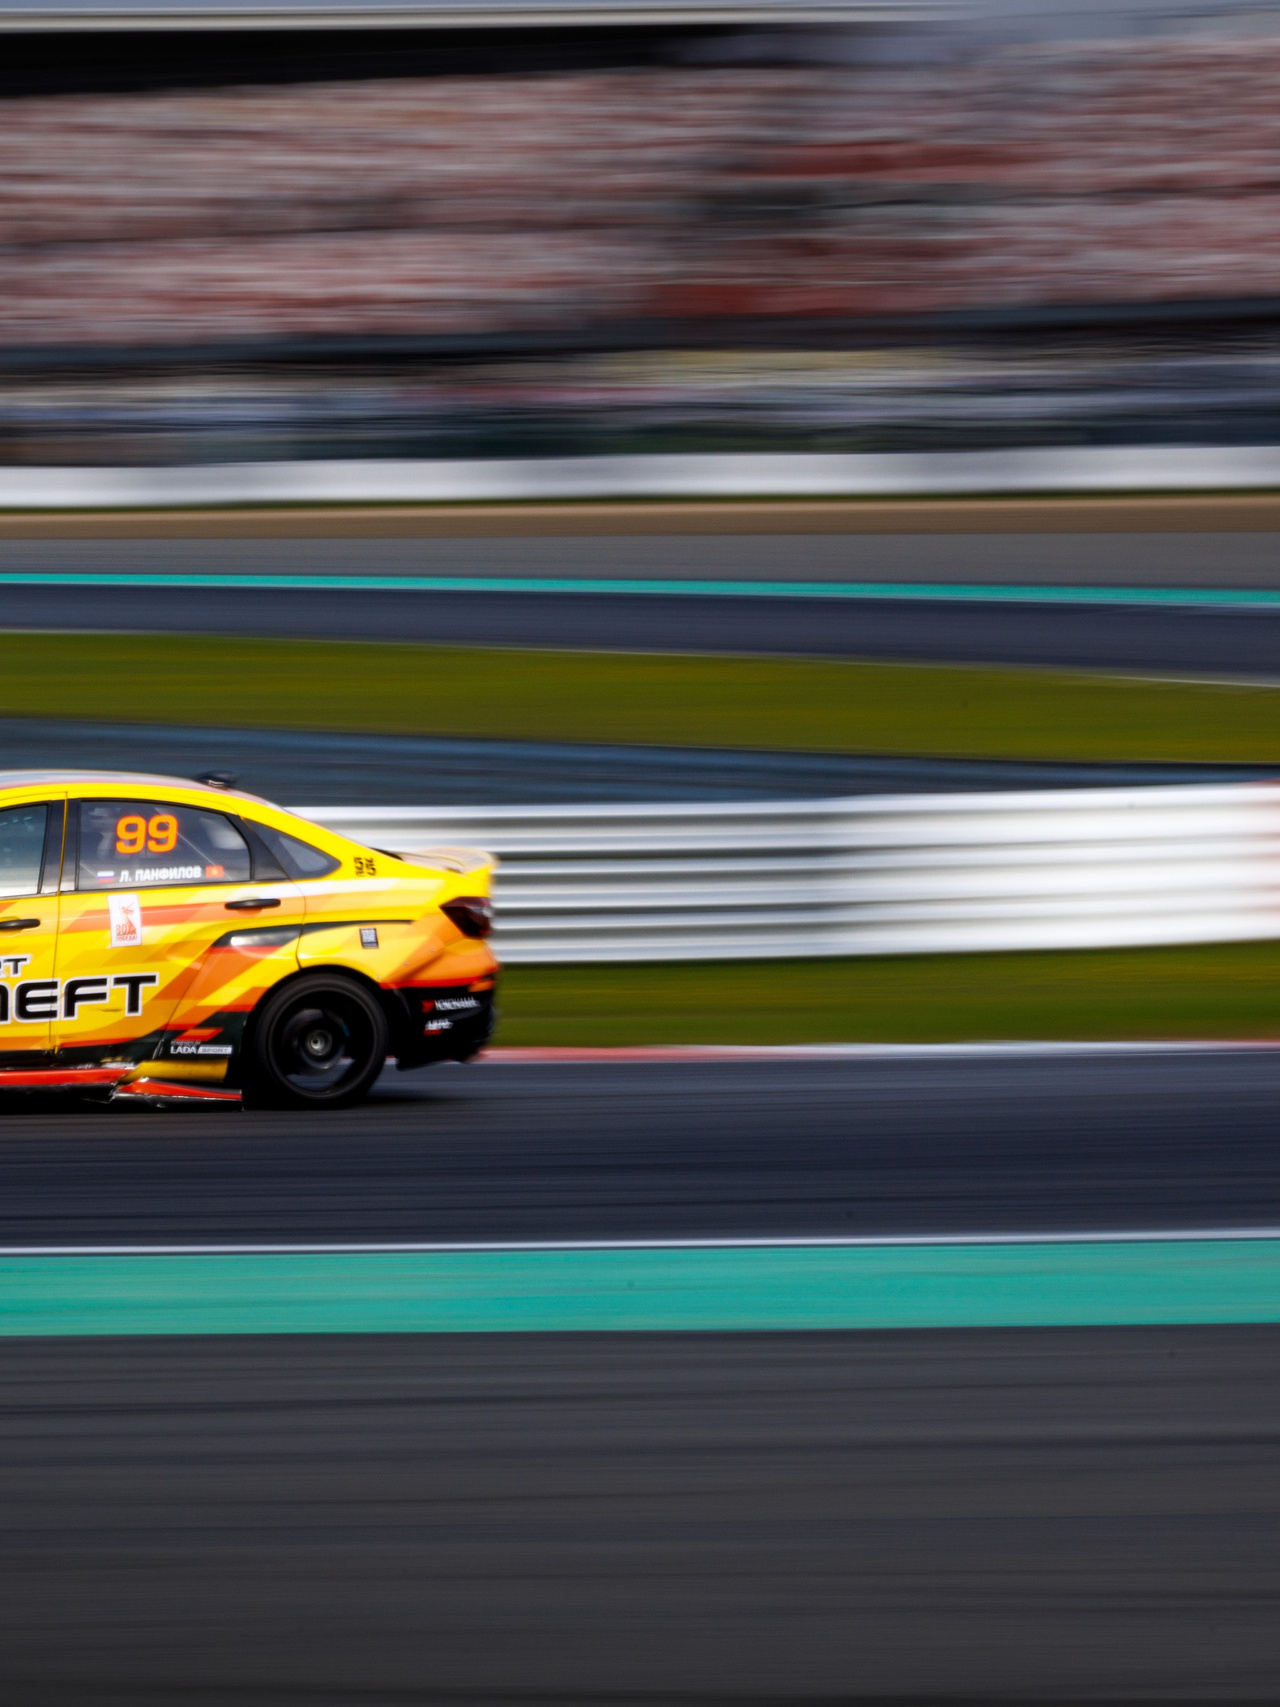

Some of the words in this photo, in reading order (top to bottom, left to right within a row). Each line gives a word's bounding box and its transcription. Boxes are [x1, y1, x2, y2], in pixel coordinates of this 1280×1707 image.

[116, 814, 178, 854] 99
[119, 870, 132, 882] Л.
[135, 865, 202, 881] ПАНФИЛОВ
[170, 1046, 197, 1054] LADA
